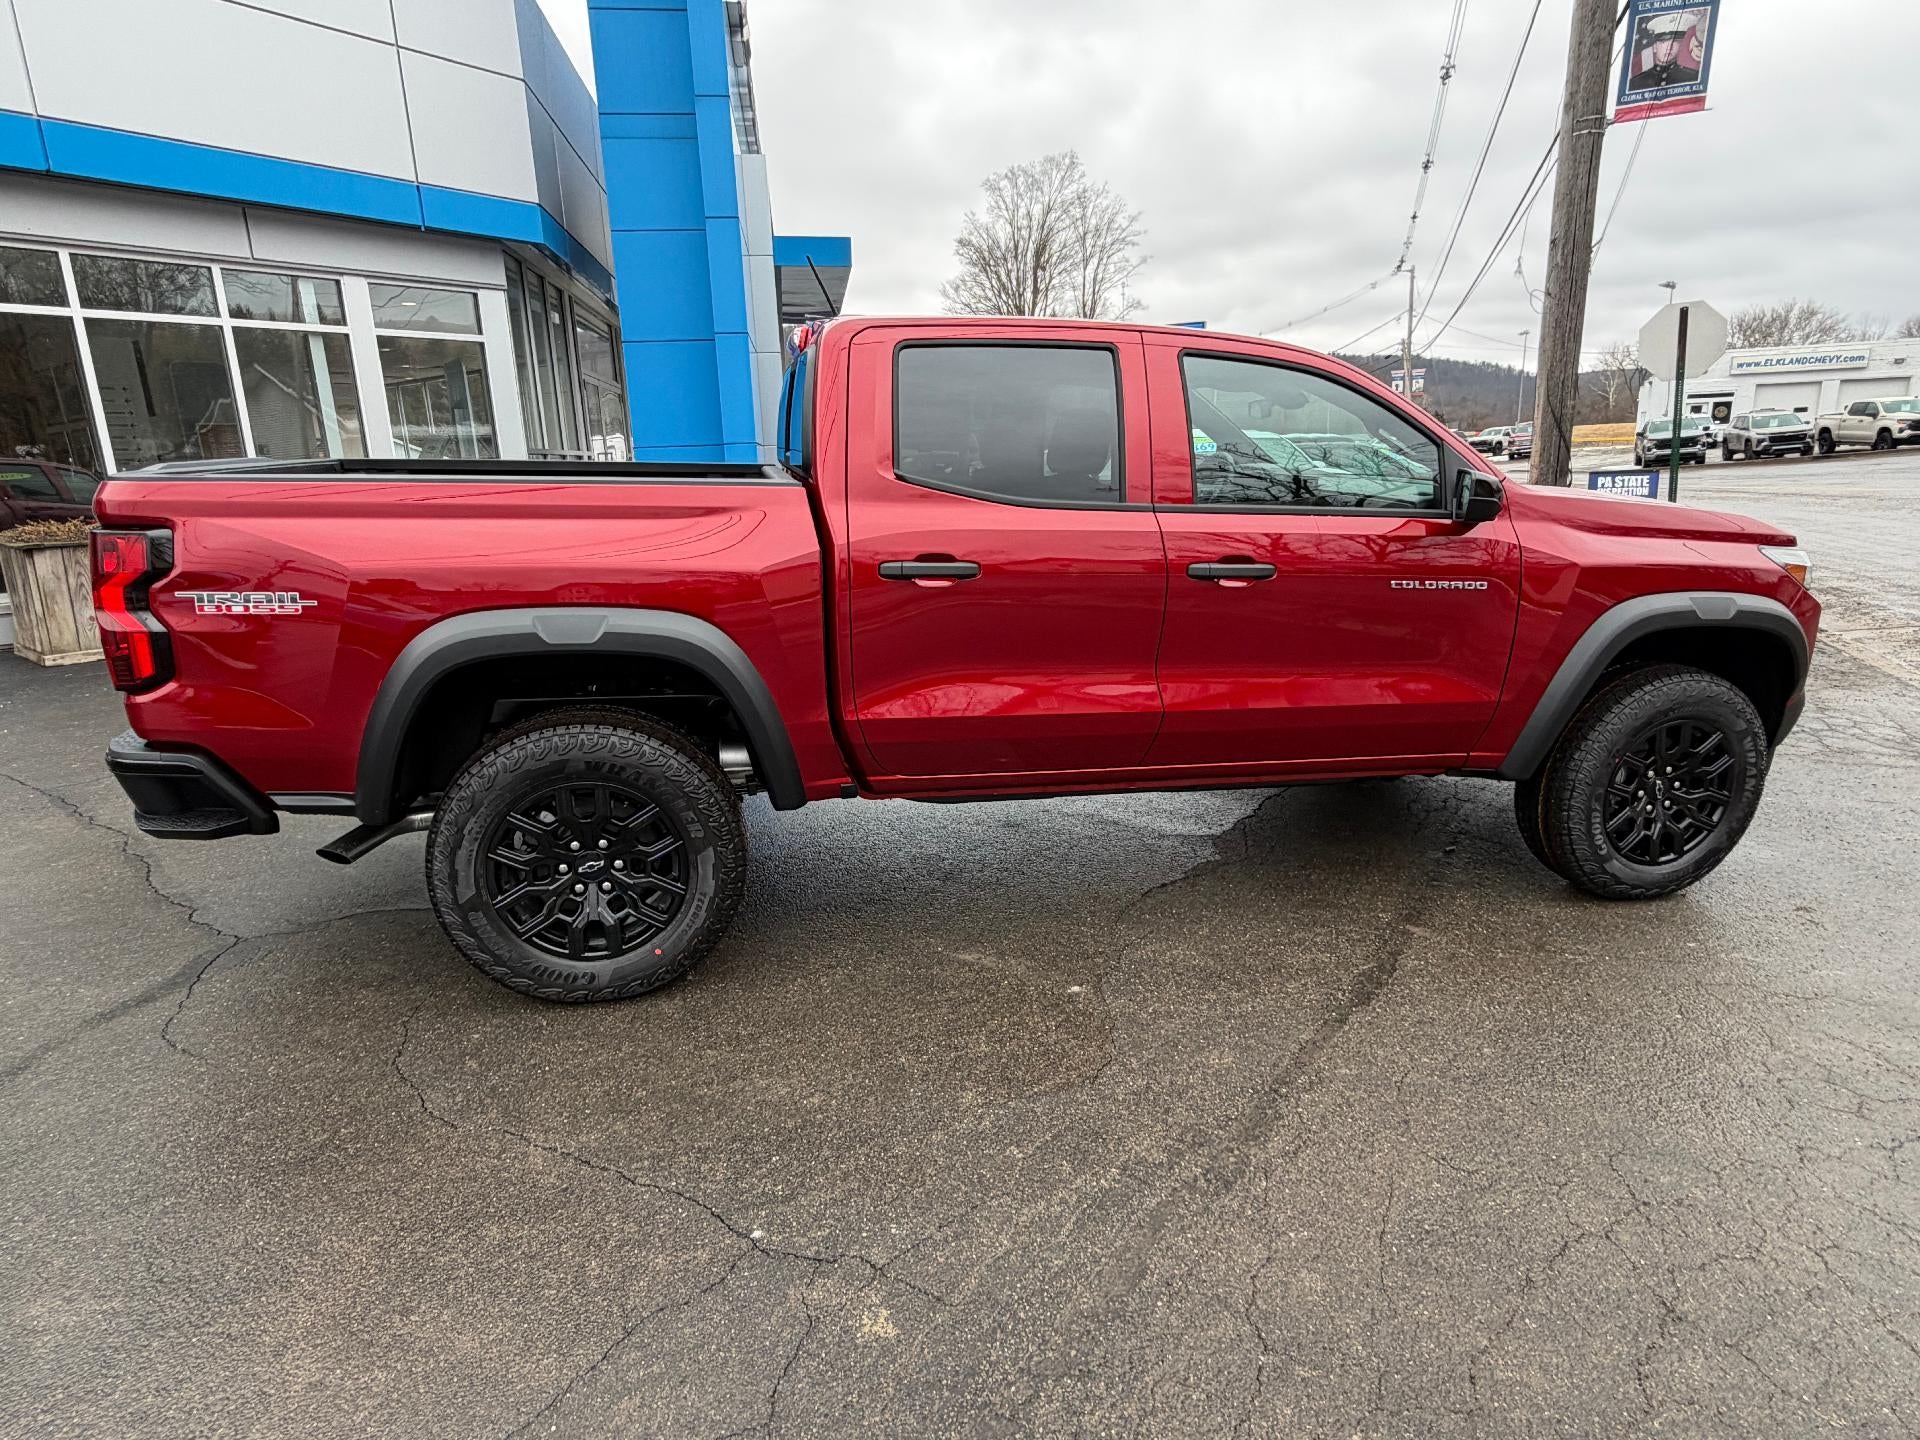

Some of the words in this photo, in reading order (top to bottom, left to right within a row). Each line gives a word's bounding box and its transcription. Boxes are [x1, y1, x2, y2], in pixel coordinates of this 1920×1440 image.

[1653, 0, 1684, 8] MARINE
[1620, 94, 1643, 102] GLOBAL
[1736, 354, 1865, 369] www.ELKLANDCHEVY.com
[1597, 476, 1612, 488] PA
[1614, 475, 1650, 487] STATE
[1390, 580, 1488, 590] COLORADO
[174, 591, 318, 606] TRAIL
[196, 604, 302, 615] BOSS
